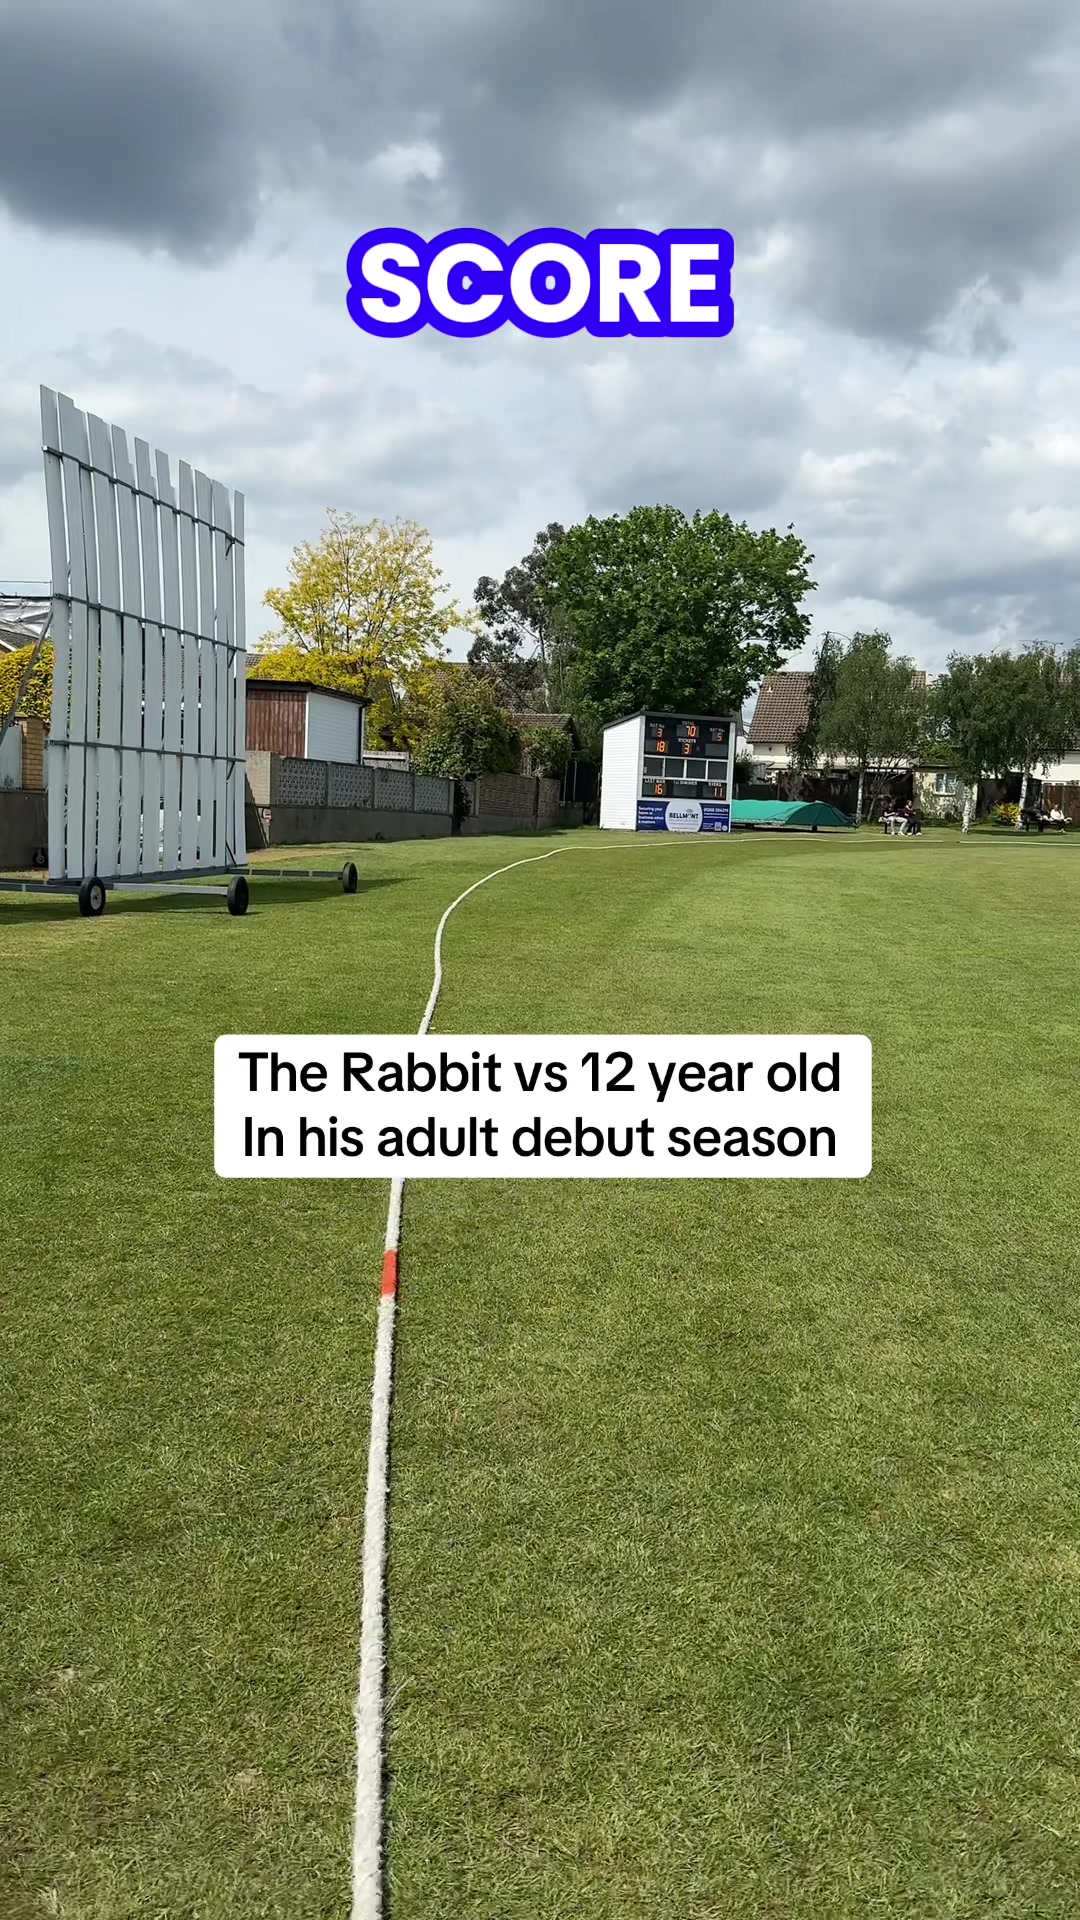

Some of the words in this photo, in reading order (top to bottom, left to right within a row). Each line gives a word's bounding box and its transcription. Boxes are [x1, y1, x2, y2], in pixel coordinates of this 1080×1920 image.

[657, 728, 663, 737] 3
[686, 726, 696, 737] 70
[717, 733, 722, 741] 5
[656, 741, 665, 752] 18
[684, 743, 690, 754] 3
[655, 784, 663, 794] 16
[714, 787, 722, 797] 11
